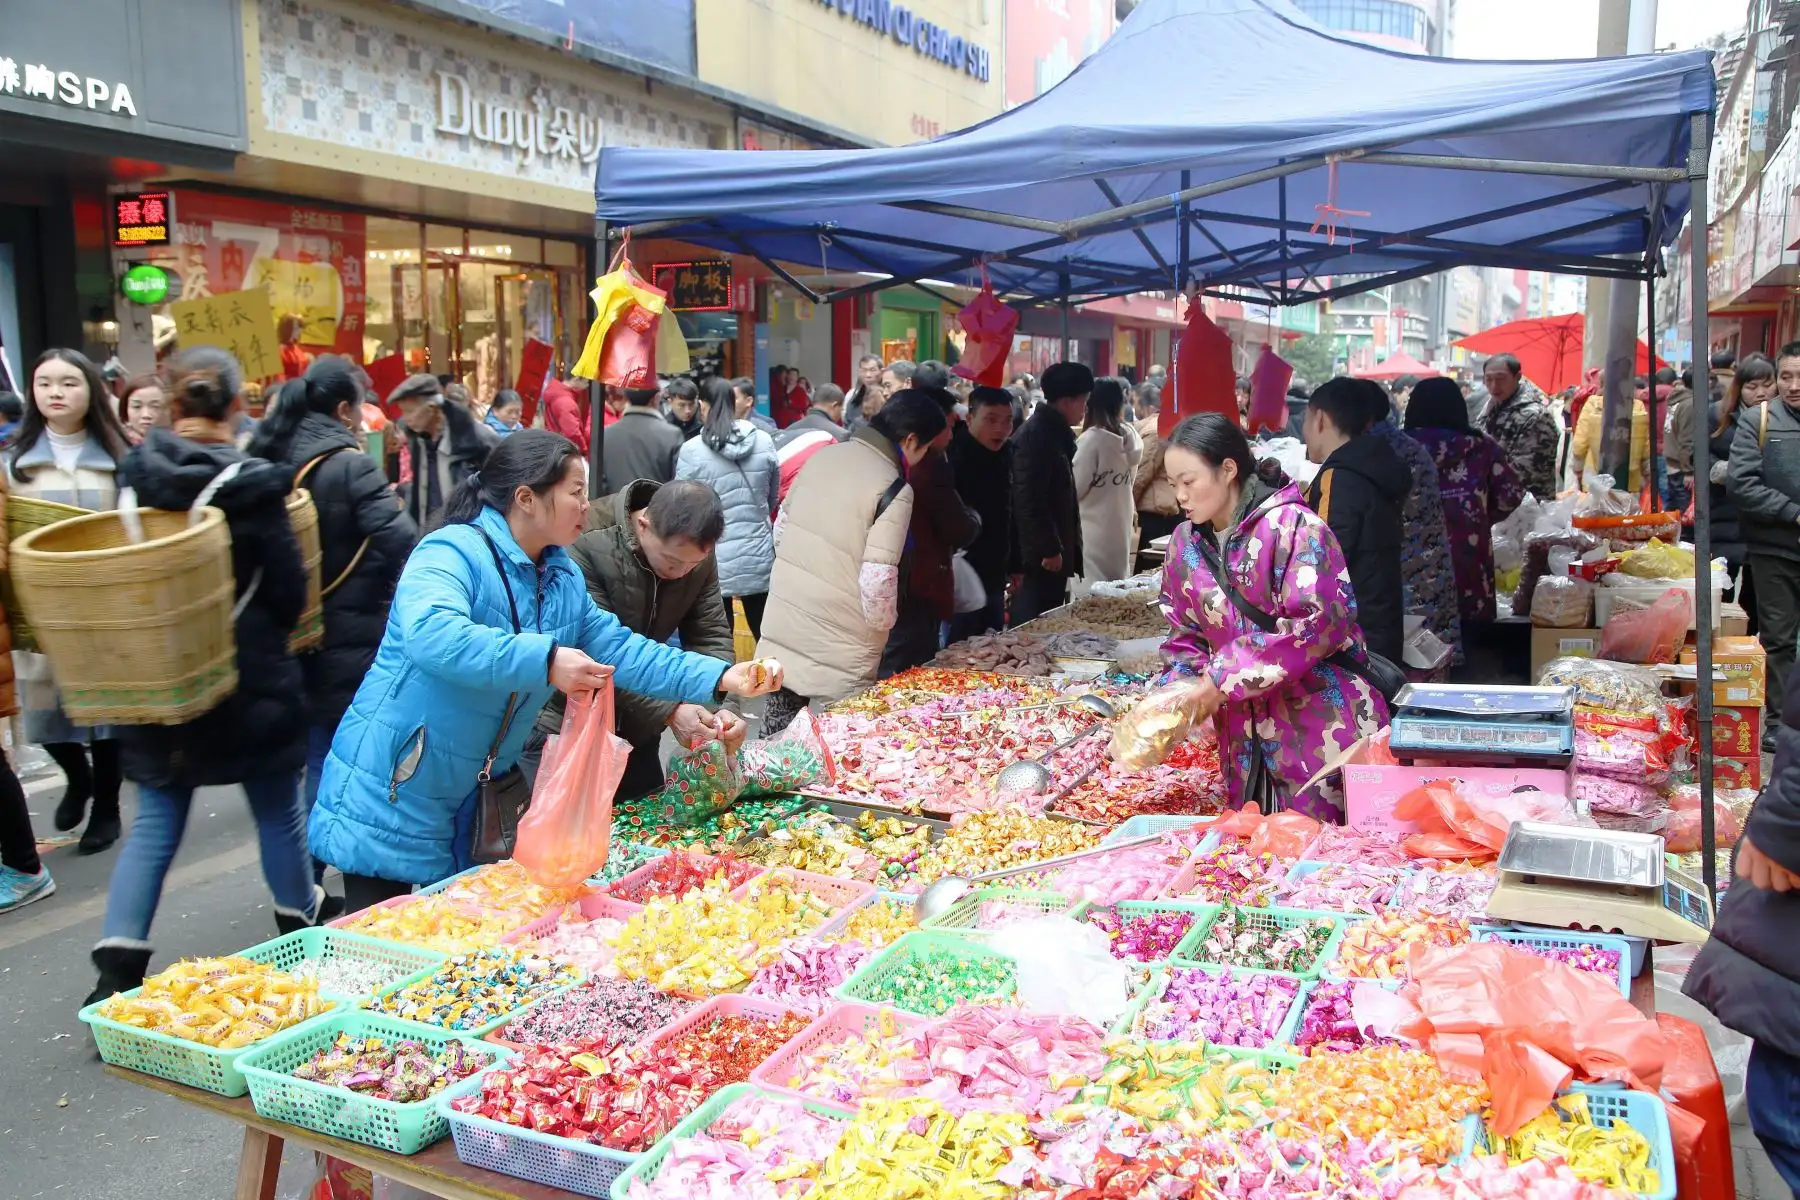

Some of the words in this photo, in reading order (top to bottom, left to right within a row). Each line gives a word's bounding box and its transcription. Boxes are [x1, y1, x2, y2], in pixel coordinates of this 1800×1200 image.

[892, 5, 914, 46] QI
[914, 18, 967, 69] CHAO
[965, 42, 990, 83] SHI
